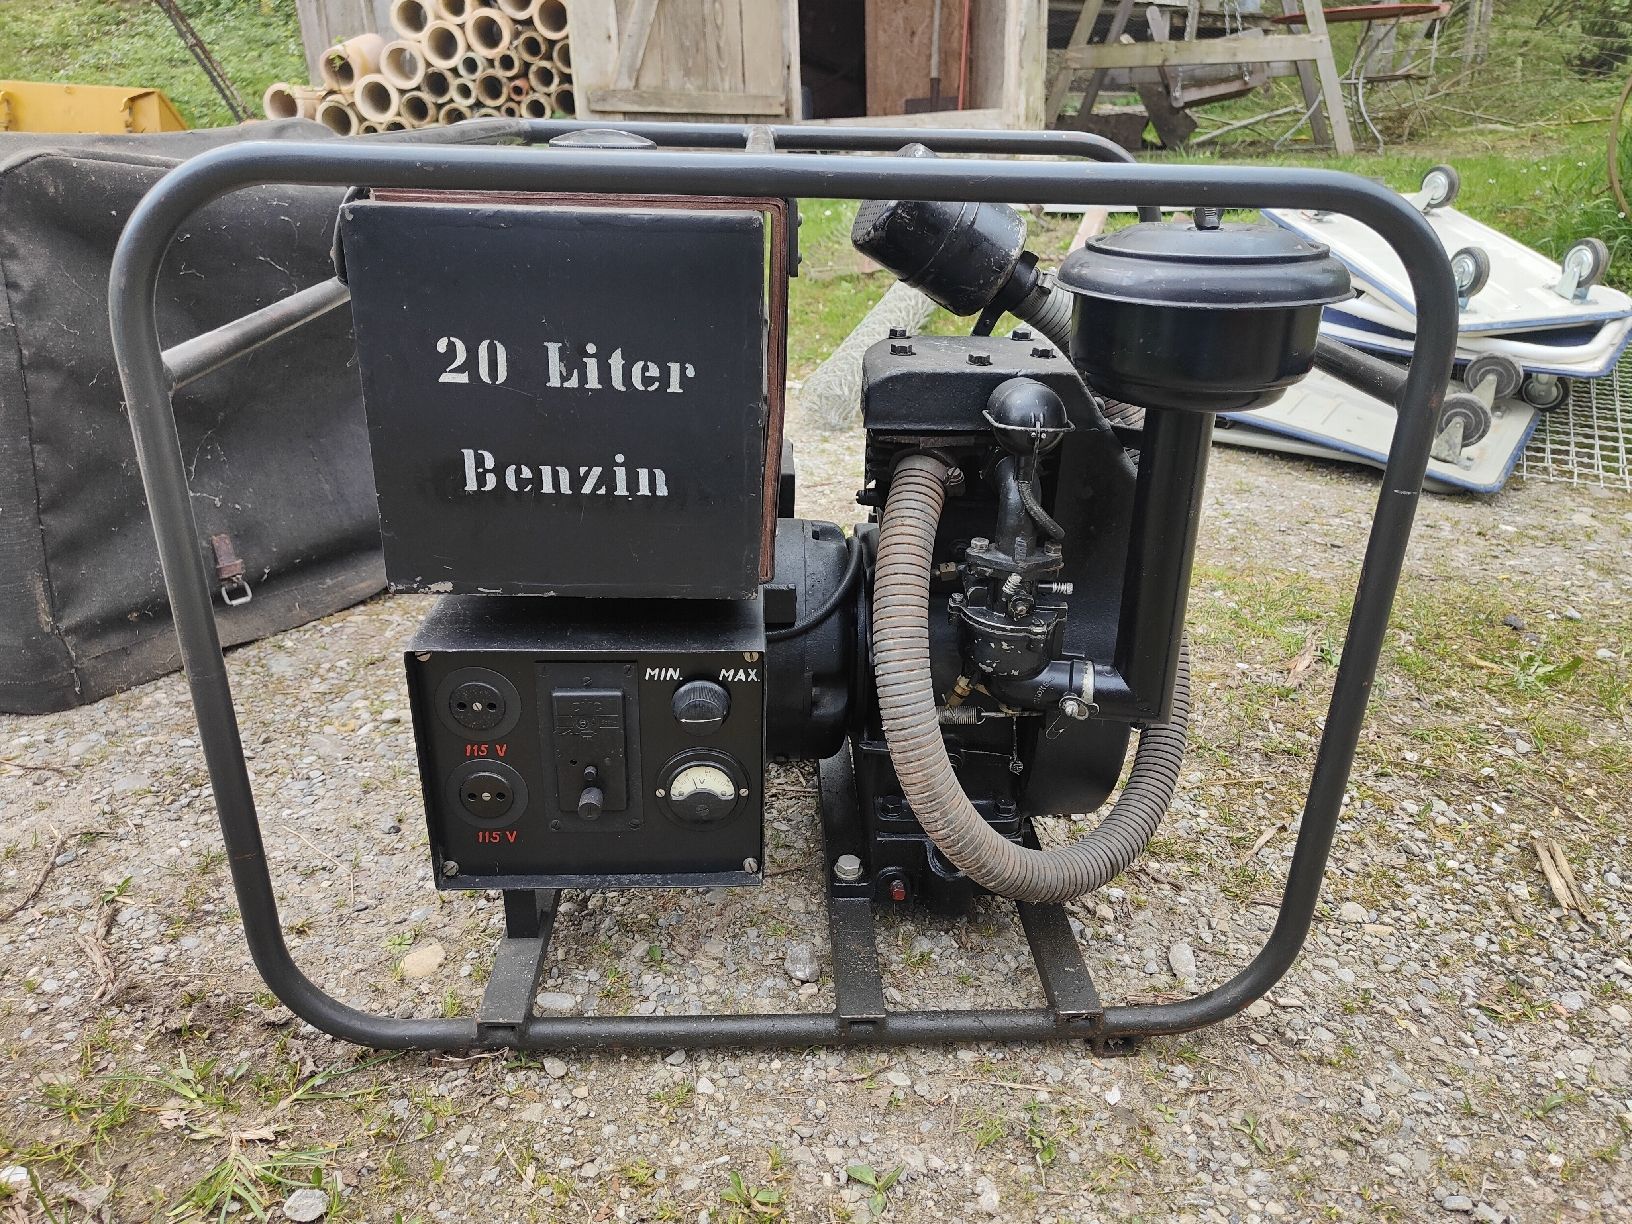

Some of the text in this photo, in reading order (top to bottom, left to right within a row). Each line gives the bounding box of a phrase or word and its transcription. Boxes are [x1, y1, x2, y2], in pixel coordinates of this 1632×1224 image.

[436, 336, 696, 393] 20 Liter
[461, 448, 669, 497] Benzin
[645, 667, 683, 681] MIN.
[465, 744, 507, 757] 115 V
[478, 830, 517, 843] 115 V
